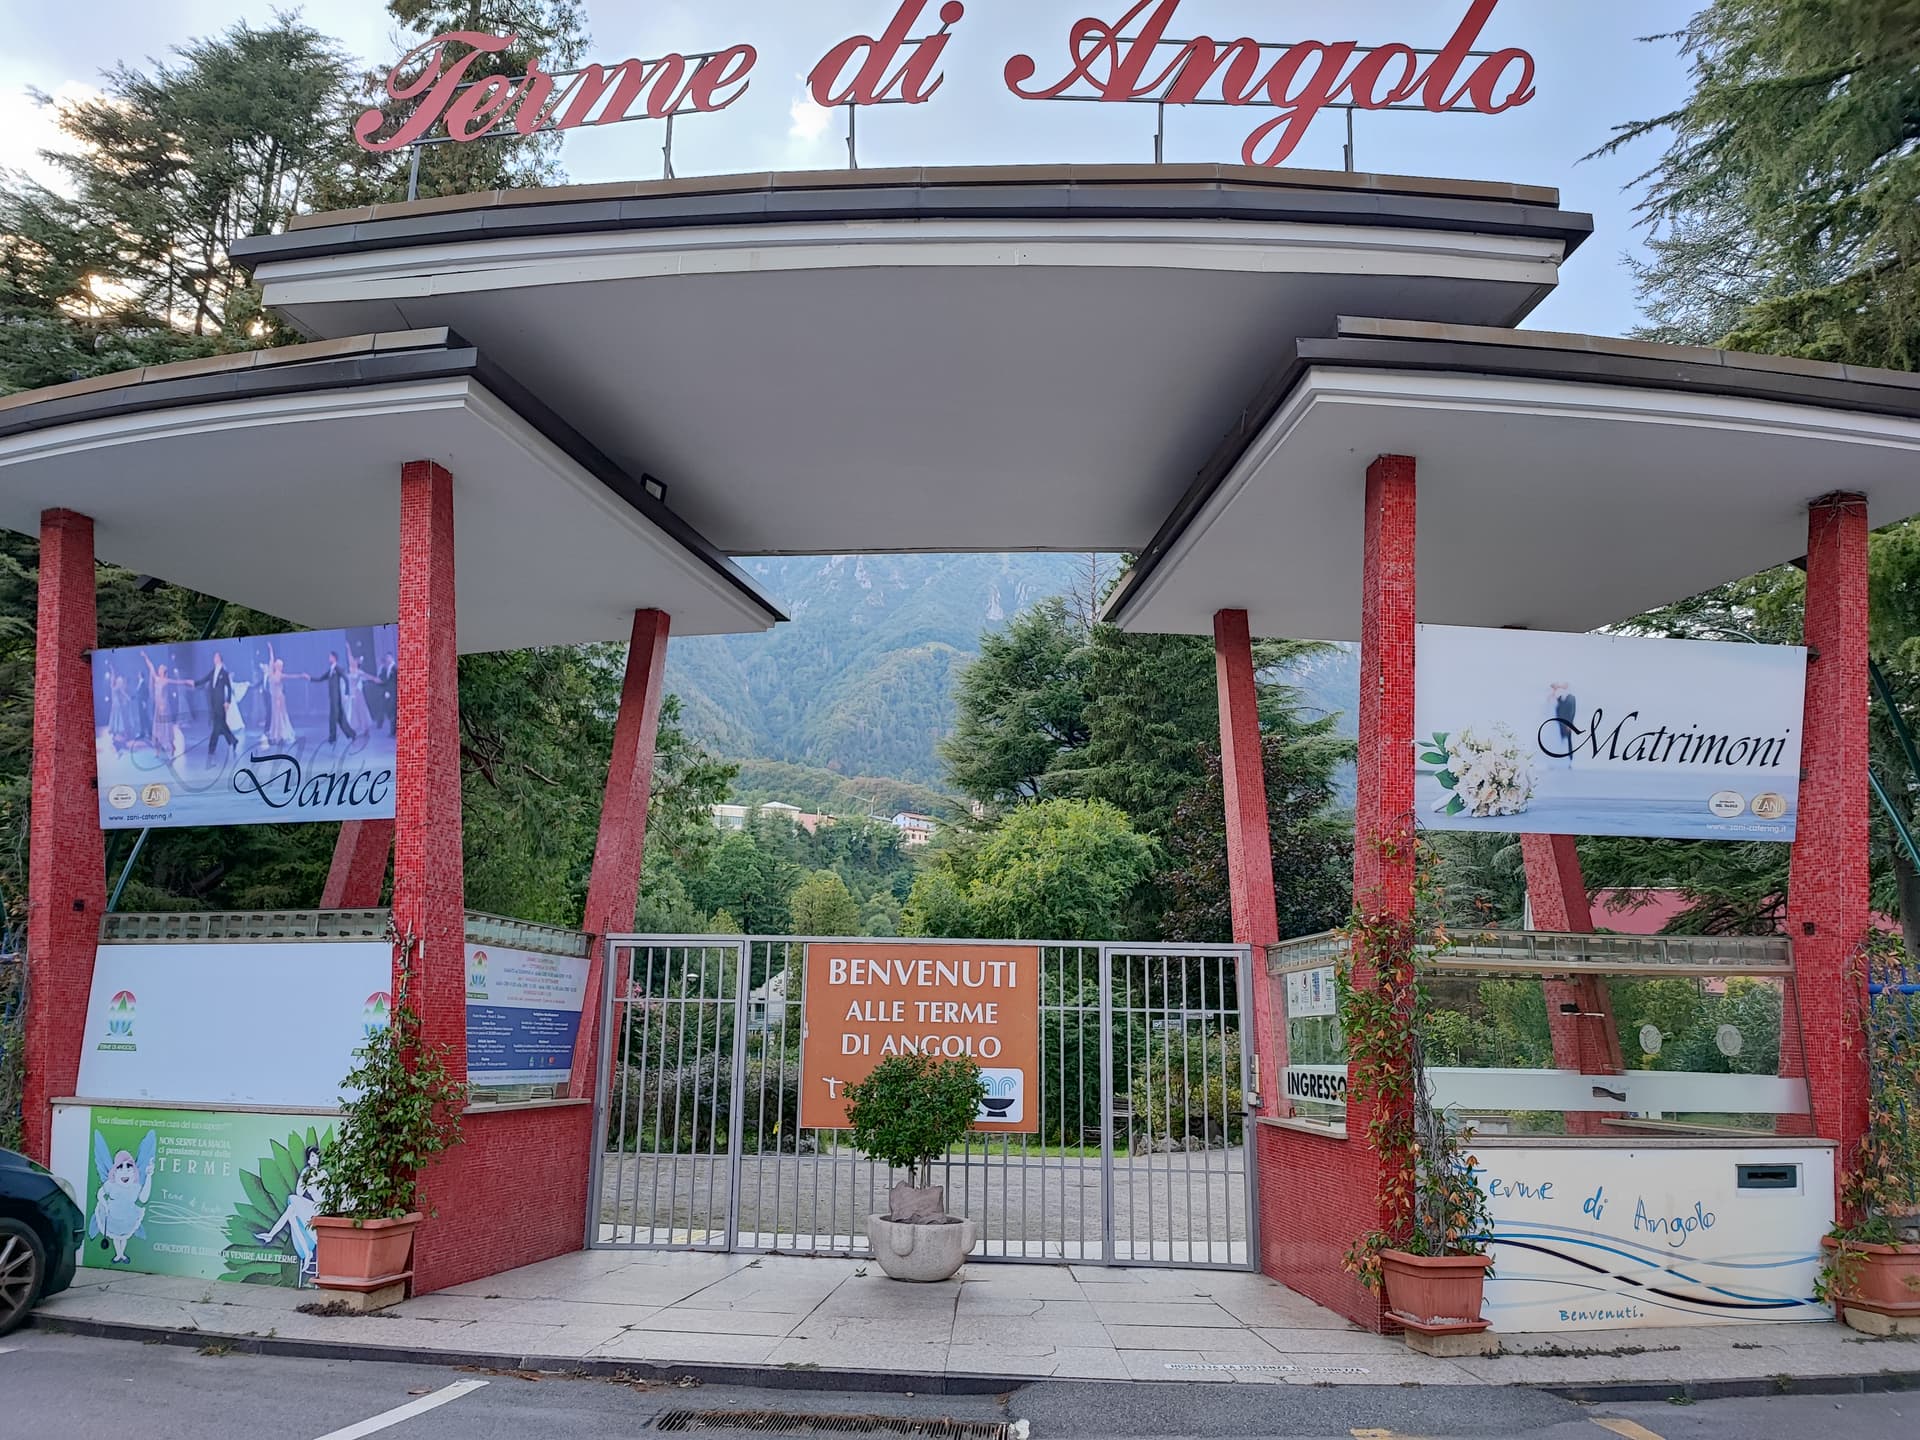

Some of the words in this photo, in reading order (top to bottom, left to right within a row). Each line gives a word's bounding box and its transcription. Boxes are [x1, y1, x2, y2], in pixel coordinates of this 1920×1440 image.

[355, 31, 758, 153] Terme
[807, 0, 962, 107] di
[1003, 0, 1537, 168] Angolo
[1537, 708, 1791, 767] Matrimoni
[232, 752, 392, 809] Dance
[829, 959, 1018, 988] BENVENUTI
[845, 1000, 905, 1022] ALLE
[914, 1001, 998, 1024] TERME
[841, 1034, 869, 1055] DI
[880, 1034, 1002, 1058] ANGOLO
[1287, 1071, 1347, 1100] INGRESSO
[159, 1137, 174, 1145] NON
[175, 1138, 197, 1146] SERVE
[159, 1158, 232, 1176] TERME
[1584, 1186, 1608, 1221] di
[1634, 1197, 1715, 1247] Angolo
[230, 1251, 256, 1260] VENIRE
[256, 1253, 273, 1261] ALLE
[274, 1255, 298, 1263] TERME
